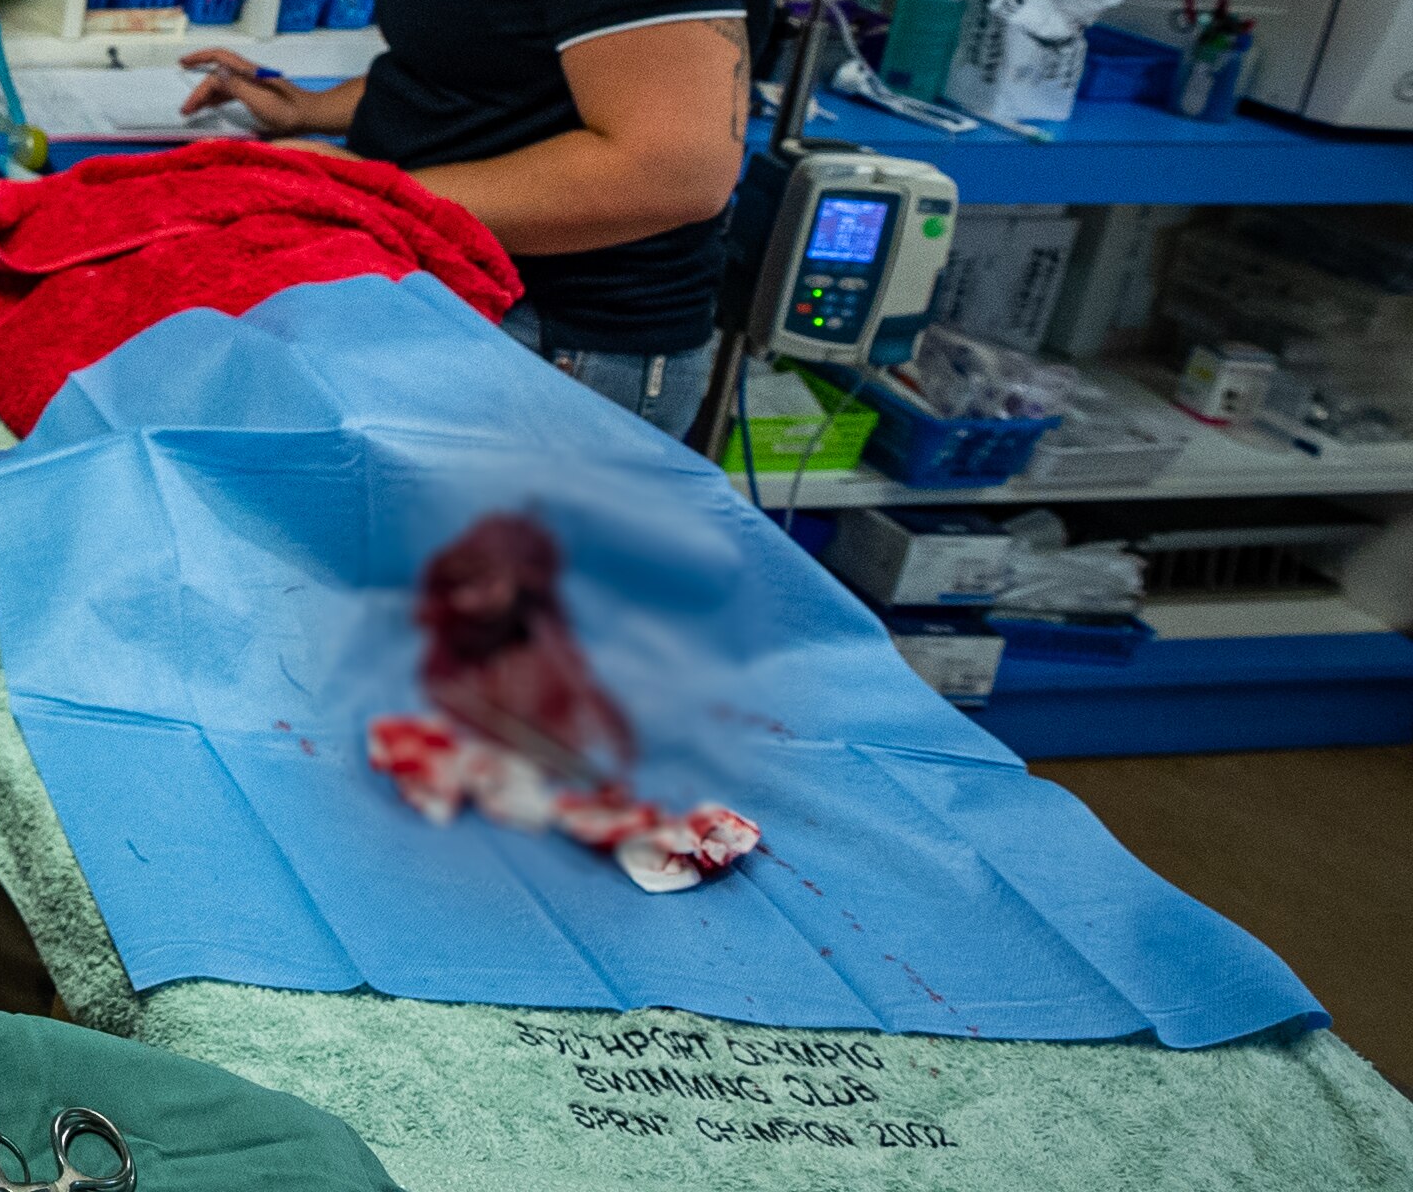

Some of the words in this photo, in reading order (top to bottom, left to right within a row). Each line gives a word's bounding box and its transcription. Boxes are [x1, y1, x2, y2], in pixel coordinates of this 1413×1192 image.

[575, 1064, 773, 1105] SWIMMING
[782, 1073, 879, 1107] CLUB
[869, 1121, 958, 1149] 2002
